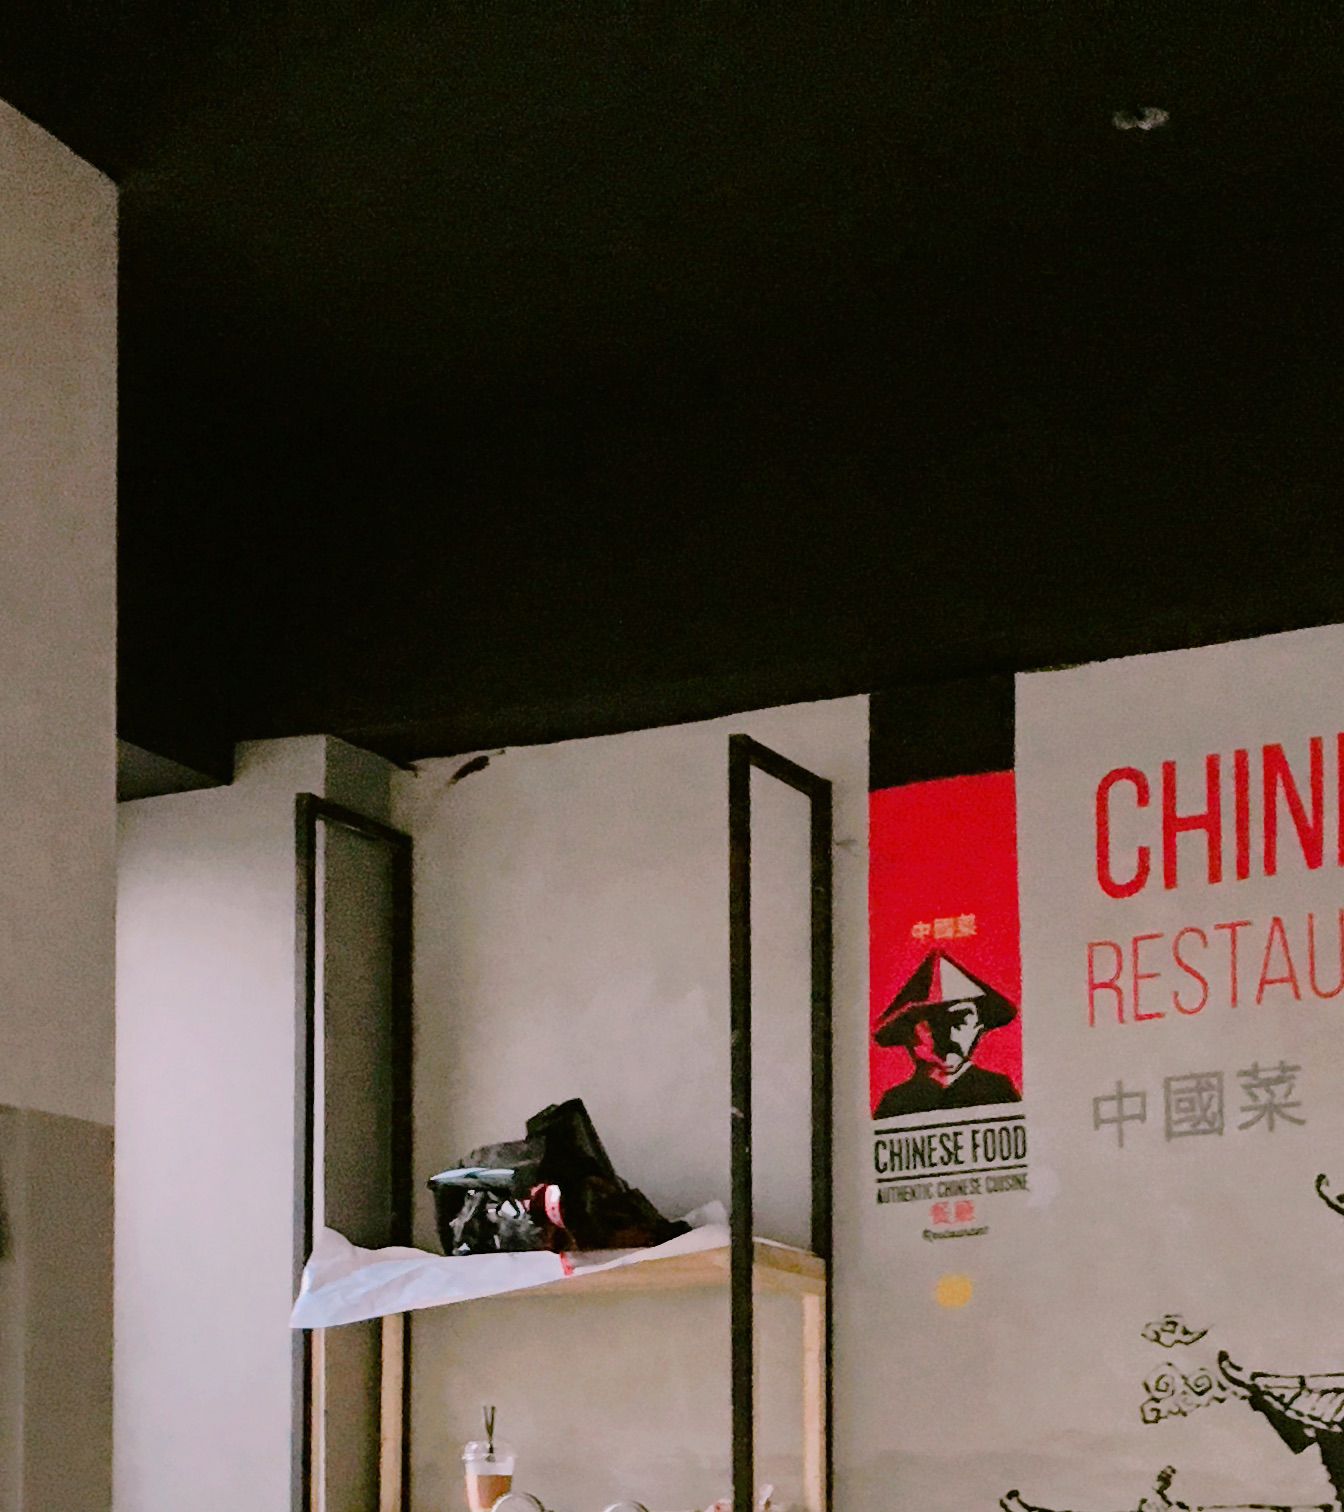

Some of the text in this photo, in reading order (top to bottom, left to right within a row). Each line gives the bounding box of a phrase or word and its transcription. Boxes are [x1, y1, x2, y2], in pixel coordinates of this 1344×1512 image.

[1091, 1060, 1307, 1149] 中國菜
[874, 1125, 1027, 1174] CHINESE FOOD
[936, 1176, 983, 1198] CHINESE
[985, 1172, 1031, 1194] CUISINE
